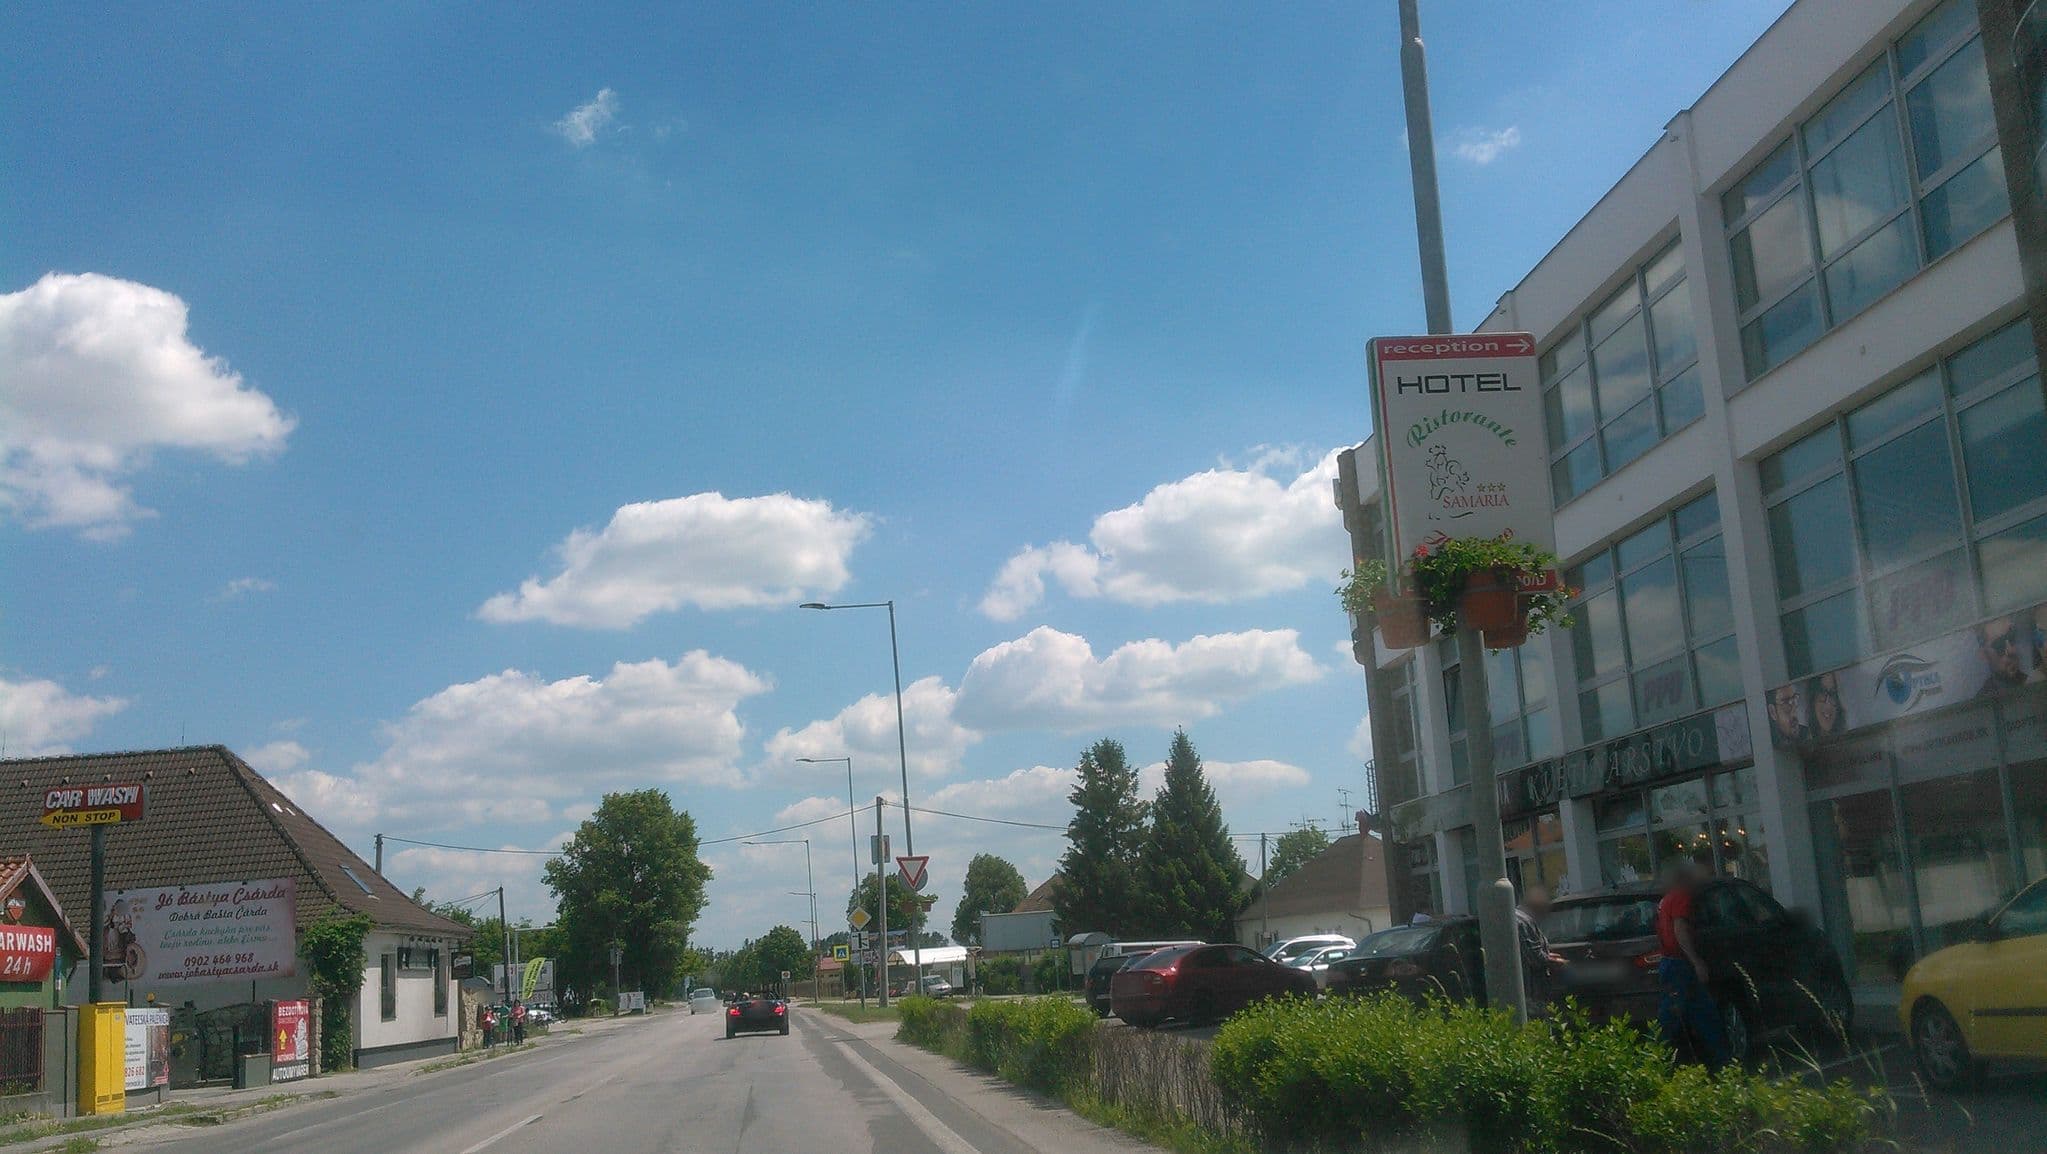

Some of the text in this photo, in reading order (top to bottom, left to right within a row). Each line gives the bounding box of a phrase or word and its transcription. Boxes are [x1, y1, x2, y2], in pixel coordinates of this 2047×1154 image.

[1384, 341, 1499, 355] reception
[1397, 373, 1522, 395] HOTEL
[1406, 407, 1517, 449] Ristorante
[1442, 494, 1510, 510] SAMARIA
[46, 786, 140, 808] CAR WASH
[52, 812, 115, 824] NON STOP
[177, 891, 229, 907] Bástya
[232, 885, 287, 905] Csárda
[169, 911, 201, 922] Dobrá
[184, 952, 254, 967] 0902 464 968
